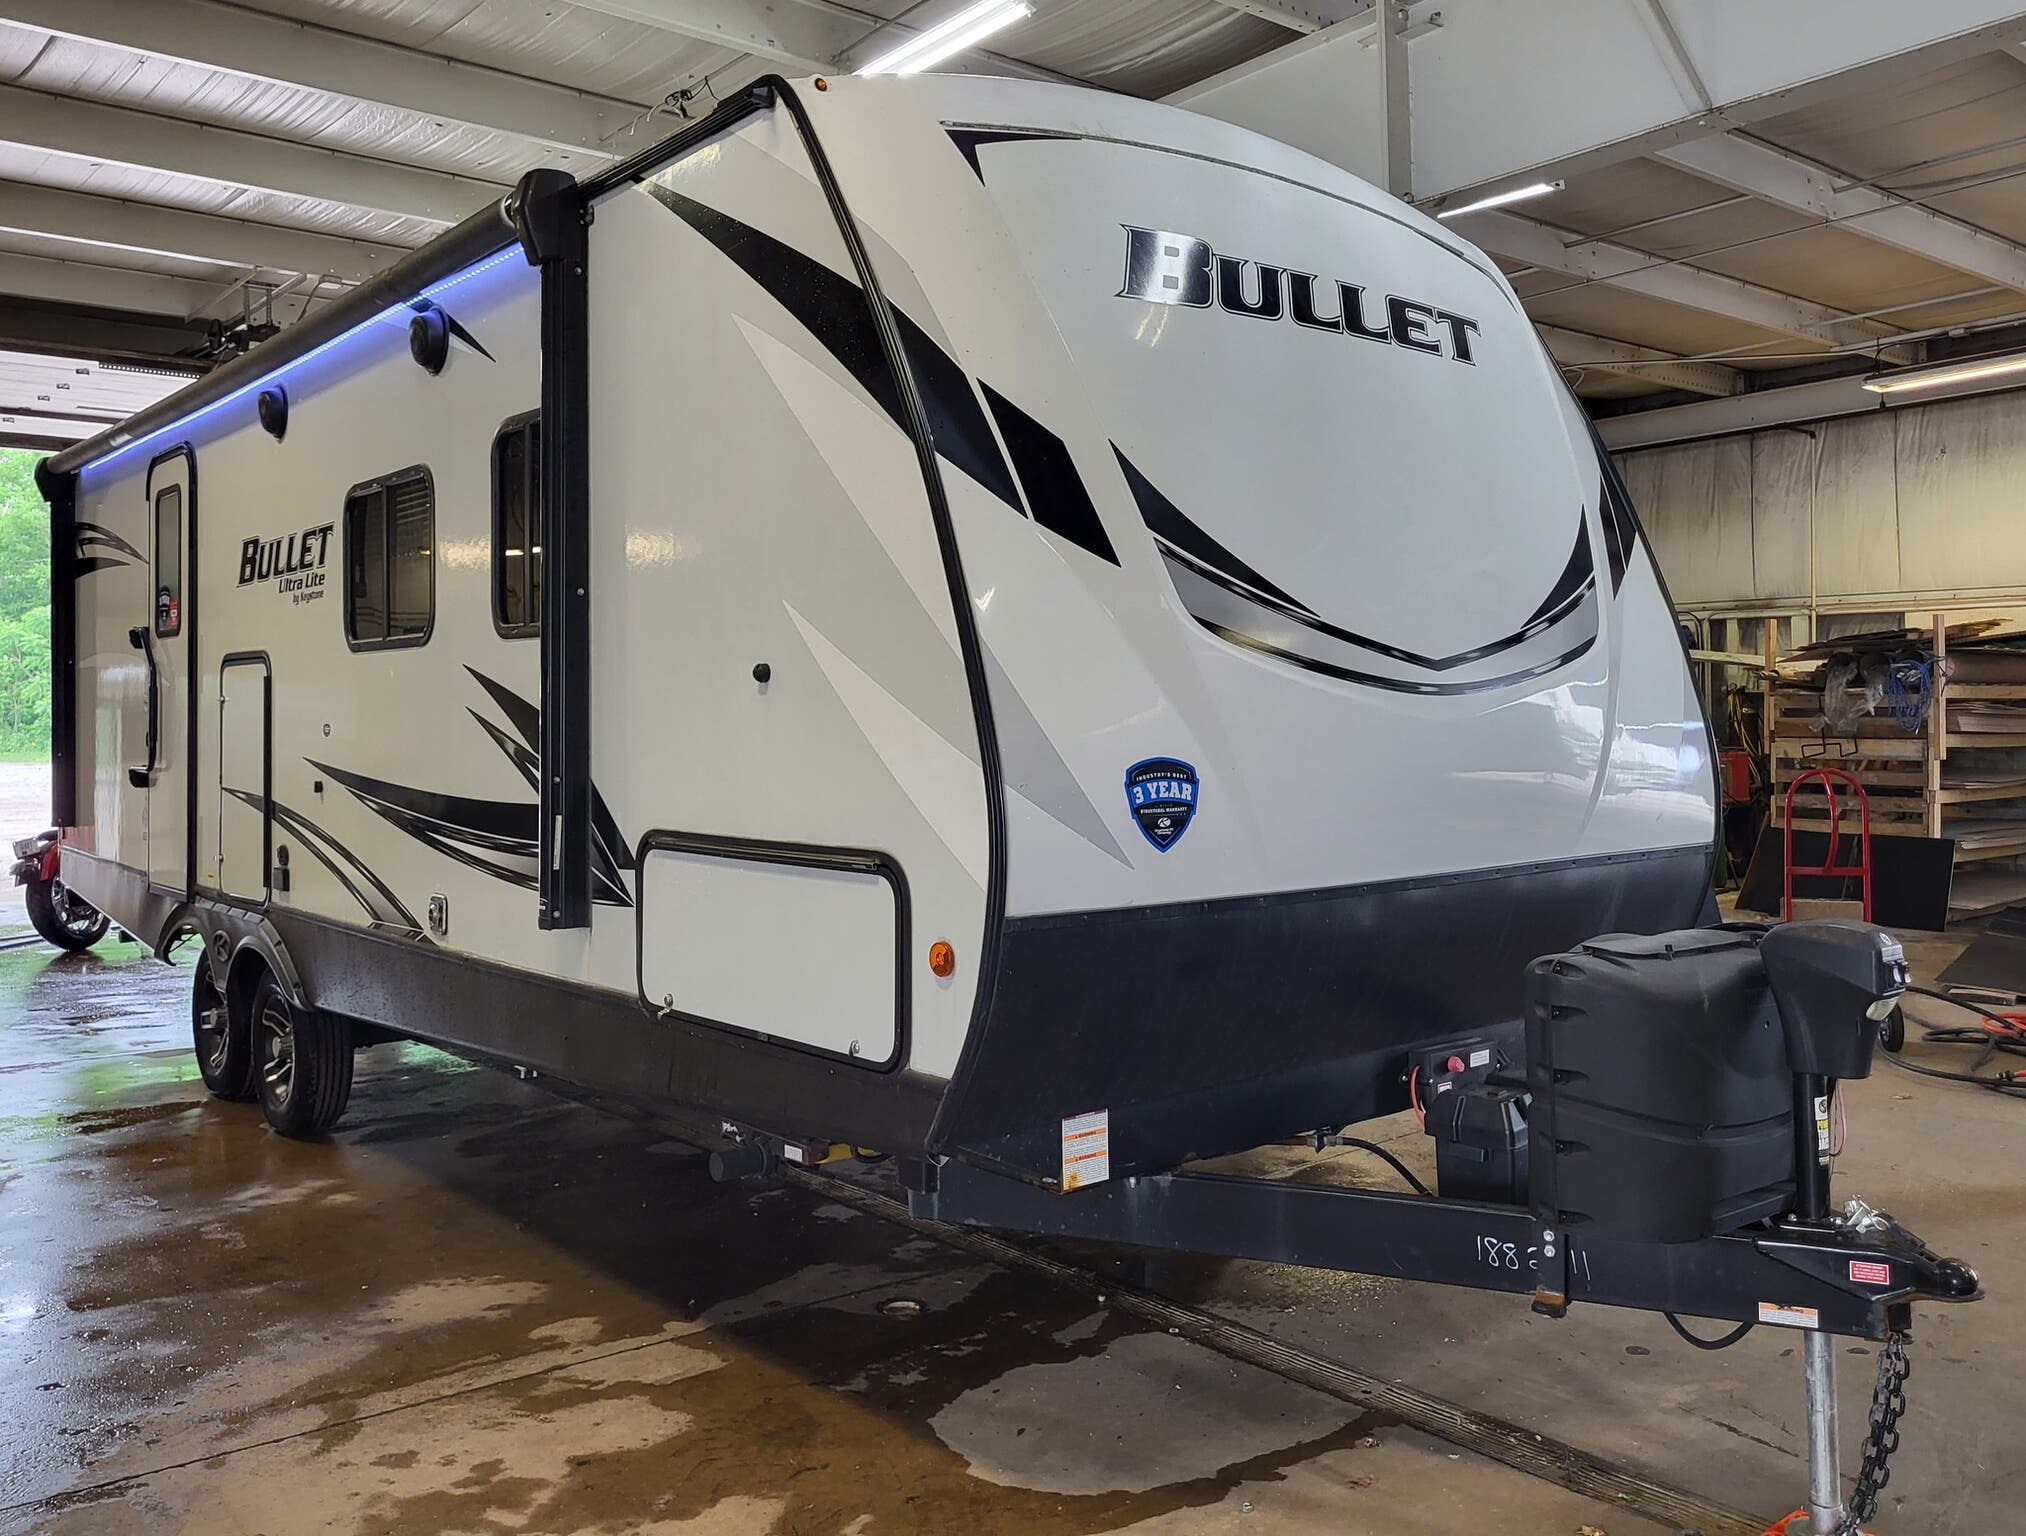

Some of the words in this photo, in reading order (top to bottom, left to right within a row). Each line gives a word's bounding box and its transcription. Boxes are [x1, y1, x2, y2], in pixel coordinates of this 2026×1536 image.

[1115, 223, 1481, 366] BULLET
[236, 521, 335, 588] BULLET
[279, 578, 303, 593] Ultra
[305, 572, 326, 588] Lite
[1133, 786, 1144, 804] 3
[1146, 781, 1192, 801] YEAR
